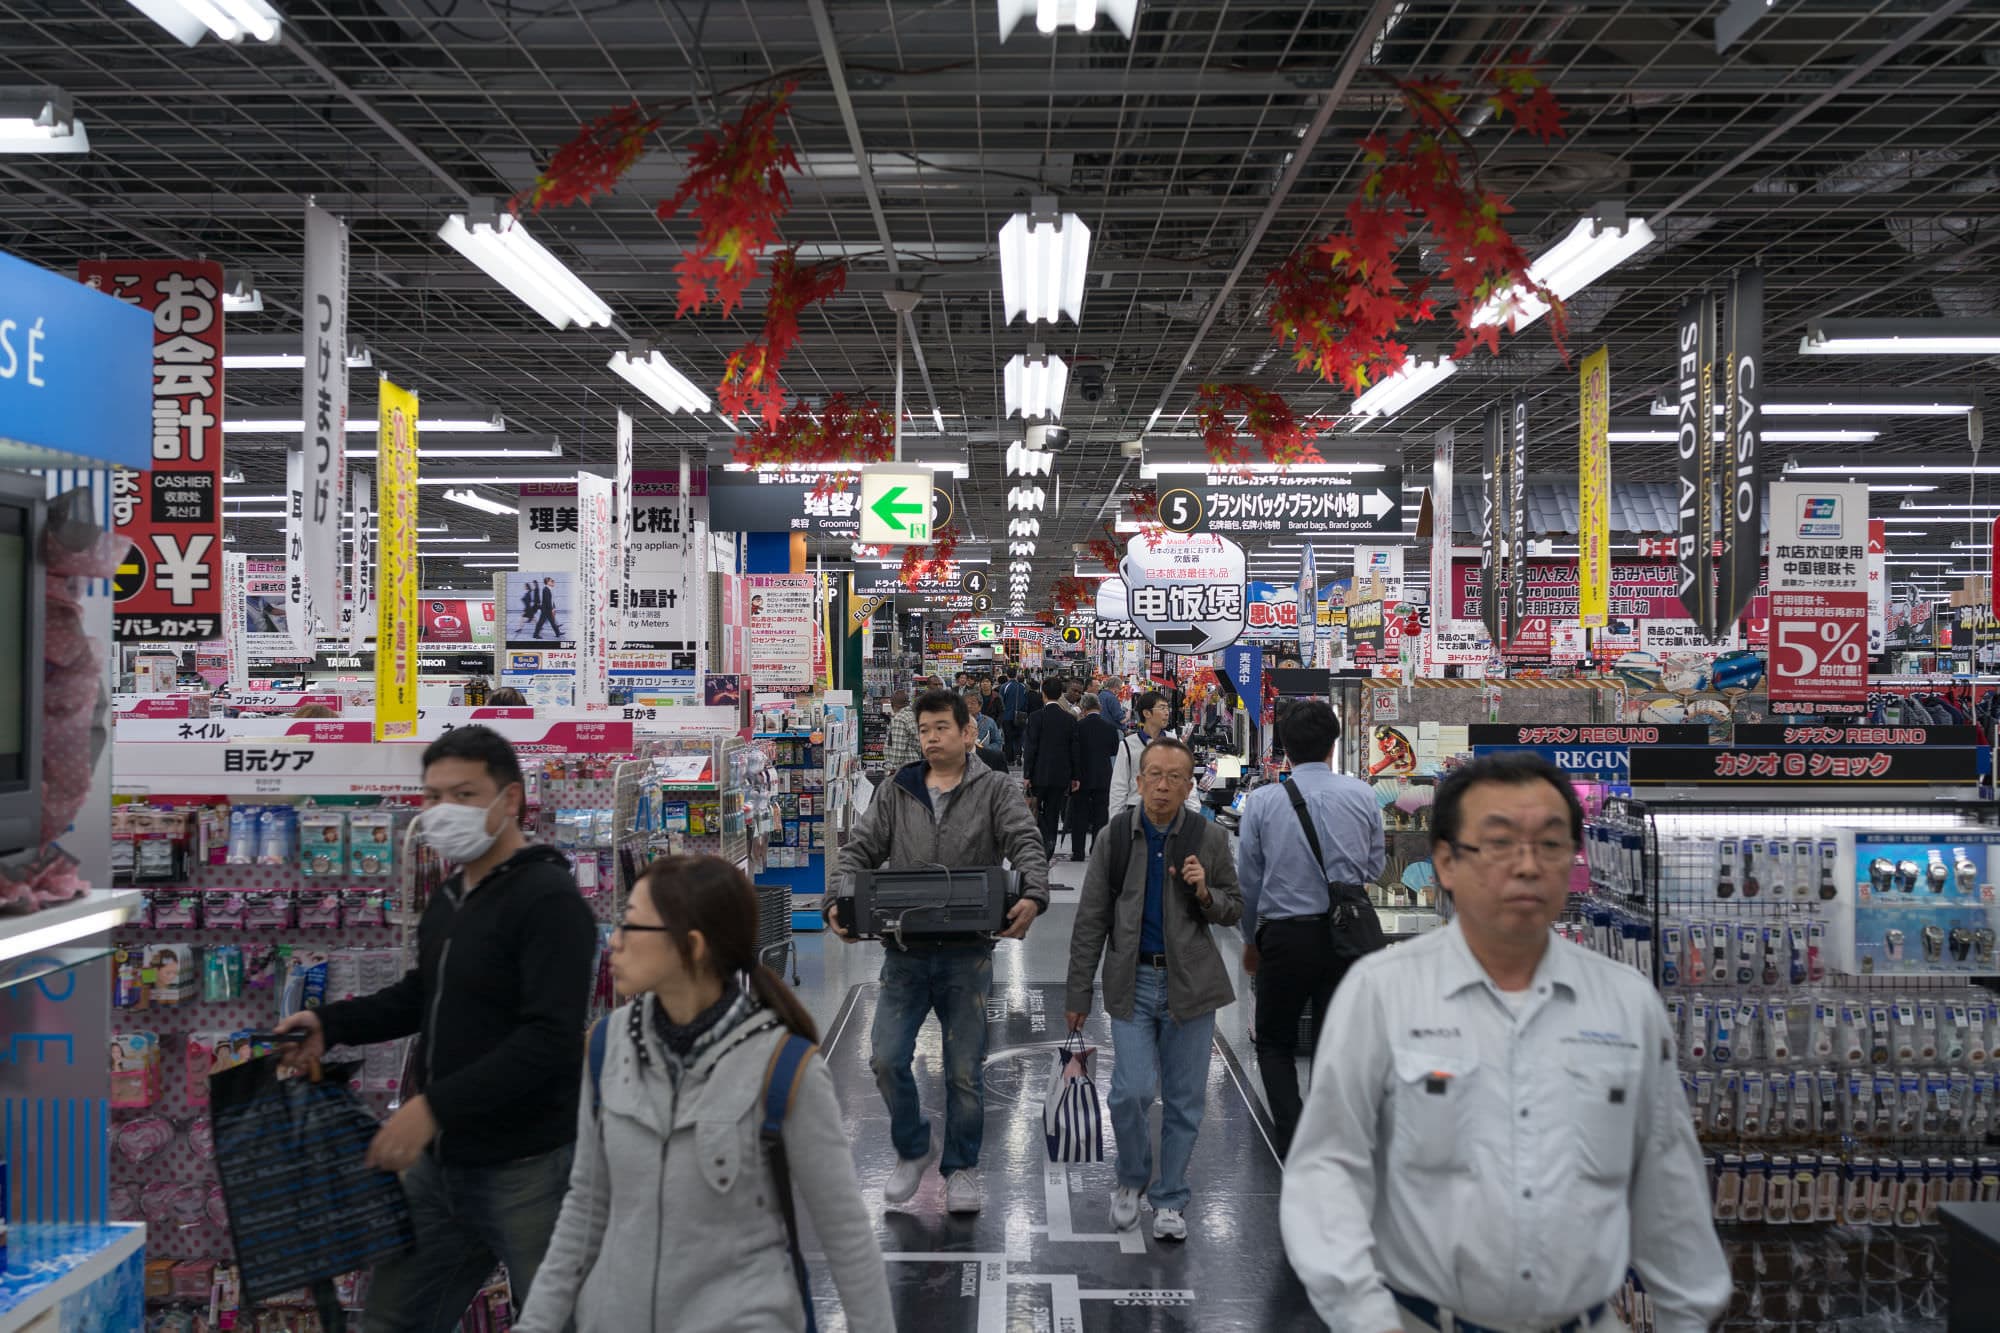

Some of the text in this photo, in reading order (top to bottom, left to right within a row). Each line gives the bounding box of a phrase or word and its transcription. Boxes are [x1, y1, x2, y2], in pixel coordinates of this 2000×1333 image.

[152, 273, 217, 461] お会計
[1737, 355, 1755, 522] CASIO
[1679, 321, 1698, 596] SEIKO ALBA
[154, 475, 213, 489] CASHIER
[803, 492, 862, 517] 理容
[1171, 497, 1188, 525] 5
[1206, 494, 1360, 518] ブランドバッグ・ブランド小物
[1515, 402, 1525, 618] CITIZEN REGUNO
[529, 507, 695, 533] 理美・化粧品
[791, 519, 810, 529] 美容
[819, 519, 860, 530] Grooming
[1288, 521, 1373, 531] Brand bags, Brand goods
[534, 541, 577, 550] Cosmetic
[644, 541, 693, 552] applians
[1776, 545, 1863, 560] 本店欢迎使用
[1783, 561, 1856, 576] 中国银联卡
[970, 575, 980, 591] 4
[1543, 586, 1581, 599] popula
[1617, 585, 1633, 597] for
[1635, 587, 1660, 599] your
[853, 594, 886, 621] FLOO
[980, 598, 986, 609] 3
[1132, 585, 1241, 621] 电饭煲
[640, 619, 670, 628] Meters
[1058, 617, 1065, 627] 2
[1437, 633, 1476, 642] 商品のご精
[1437, 642, 1491, 651] にてお願い致し
[1776, 620, 1861, 678] 5%
[1447, 654, 1489, 662] ヨドバシカメ
[616, 677, 695, 688] 消費カロリーチェッ
[235, 695, 277, 705] プロテイン
[623, 708, 657, 720] 耳かき
[178, 722, 226, 739] ネイル
[576, 733, 589, 741] Nail
[1518, 727, 1659, 744] シチズン REGUNO
[1783, 728, 1927, 744] シチズン REGUNO
[224, 749, 314, 772] 目元ケア
[1554, 751, 1630, 769] REGUN
[1714, 753, 1893, 776] カシオ G ショック
[1112, 1299, 1191, 1307] TOKYO
